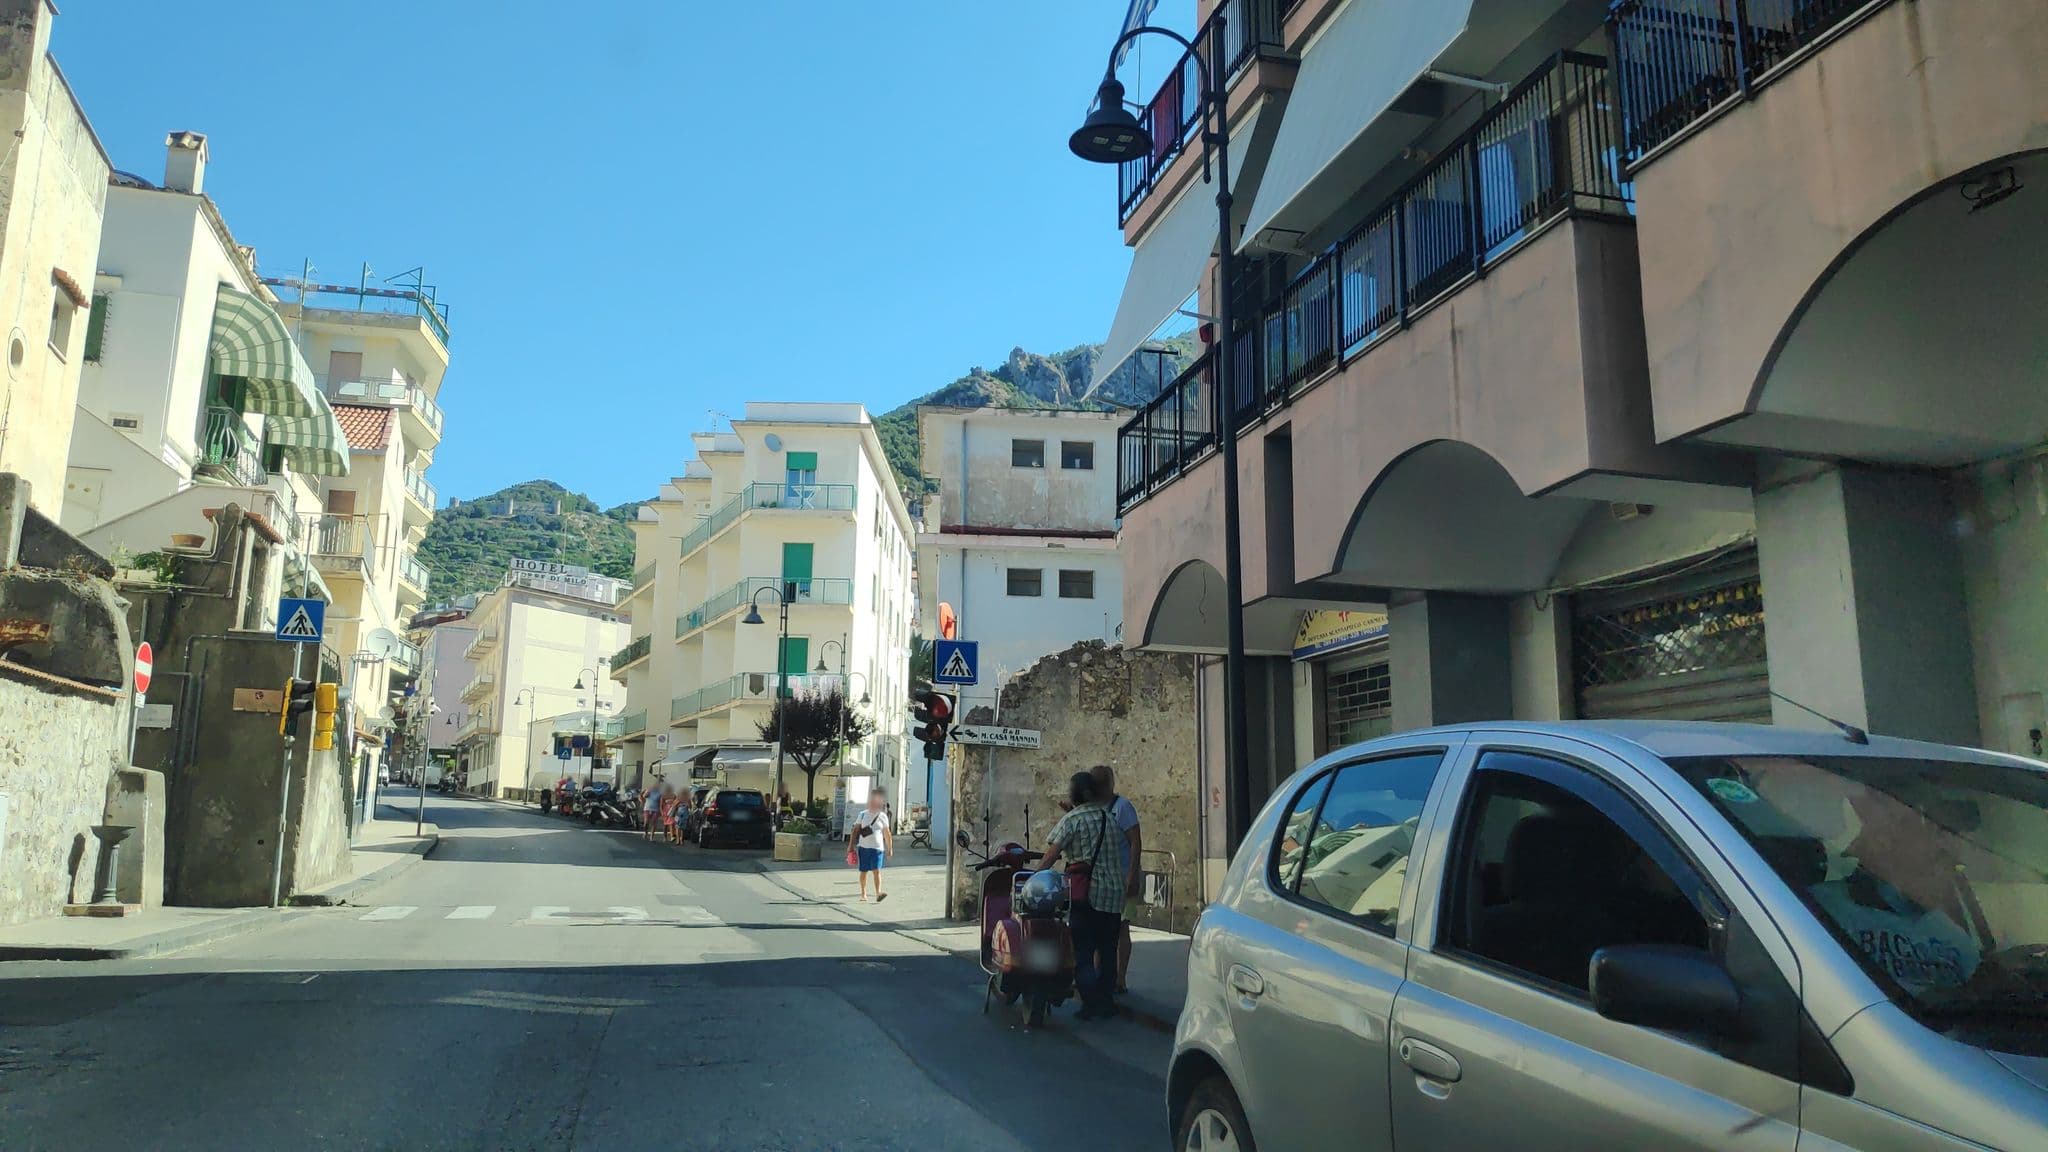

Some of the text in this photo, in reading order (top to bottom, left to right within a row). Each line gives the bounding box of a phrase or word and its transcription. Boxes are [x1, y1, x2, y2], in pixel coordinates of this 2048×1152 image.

[516, 560, 567, 574] HOTEL
[564, 577, 587, 585] MILO
[1010, 735, 1038, 743] MANNINI
